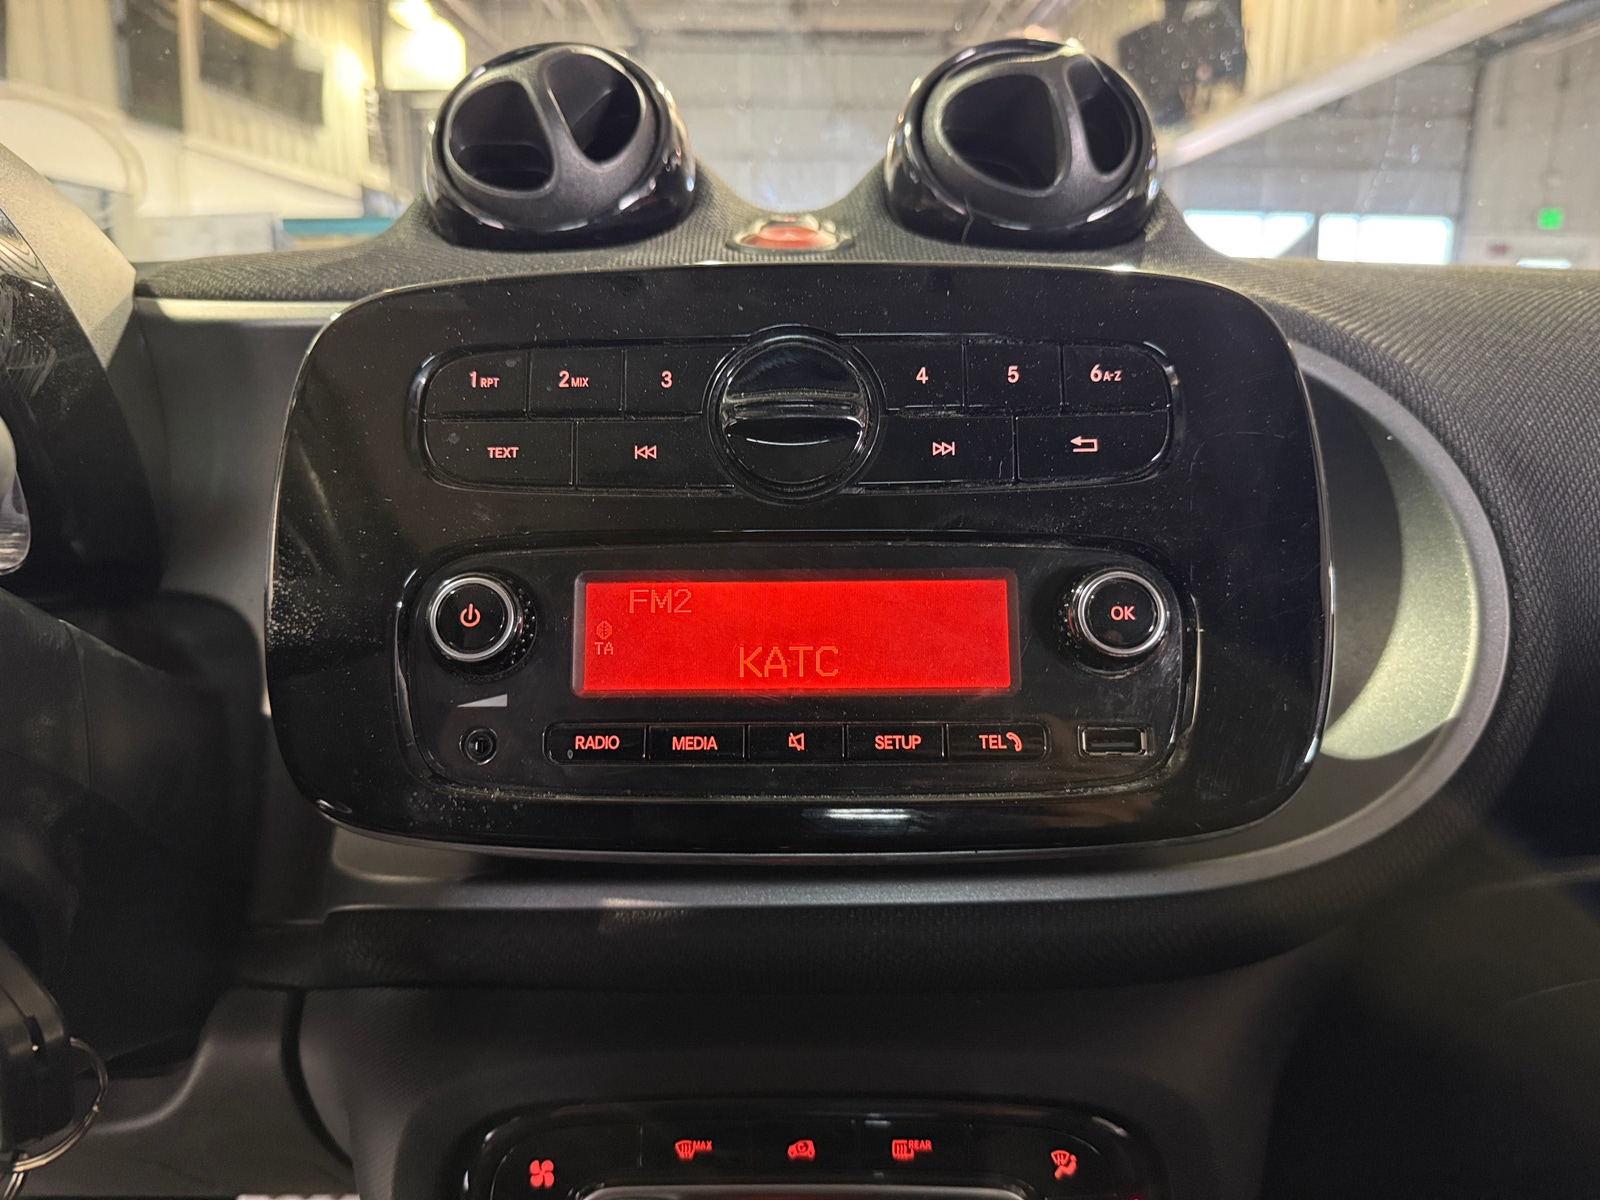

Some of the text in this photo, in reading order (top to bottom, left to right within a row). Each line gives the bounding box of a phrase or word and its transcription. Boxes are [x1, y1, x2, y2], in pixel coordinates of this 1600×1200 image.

[661, 371, 673, 388] 3
[915, 366, 929, 384] 4
[1007, 365, 1019, 383] 5
[480, 377, 500, 388] RPT
[571, 377, 589, 388] MIX
[487, 446, 519, 459] TEXT
[629, 588, 692, 614] FM2
[1110, 605, 1136, 621] OK
[594, 641, 614, 655] TA
[739, 645, 839, 678] KATC
[575, 735, 620, 750] RADIO
[672, 736, 718, 751] MEDIA
[874, 734, 922, 750] SETUP
[979, 734, 1007, 749] TEL
[693, 1140, 712, 1150] MAX
[908, 1140, 932, 1151] REAR
